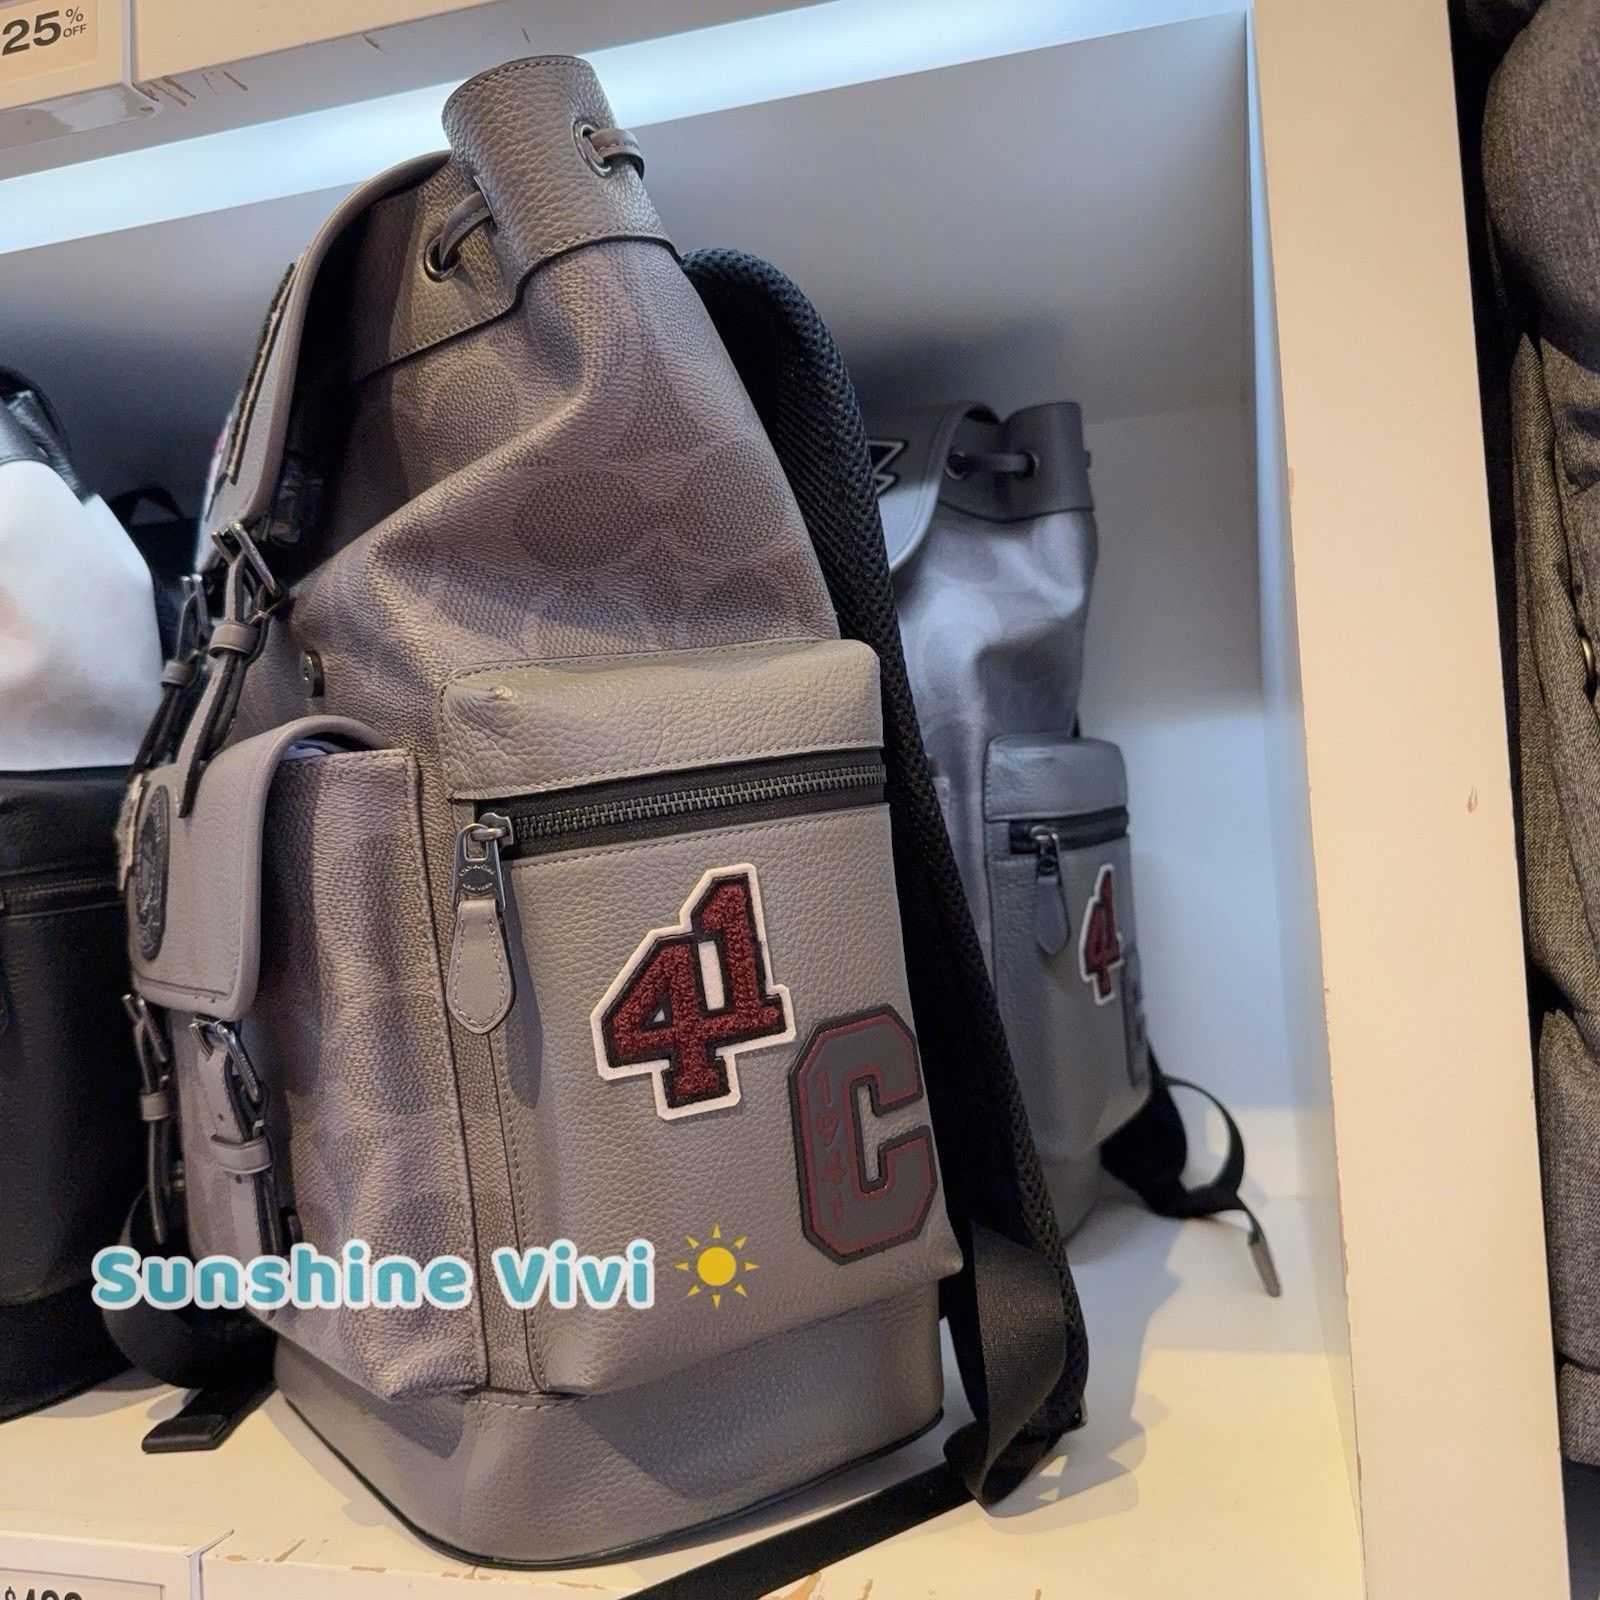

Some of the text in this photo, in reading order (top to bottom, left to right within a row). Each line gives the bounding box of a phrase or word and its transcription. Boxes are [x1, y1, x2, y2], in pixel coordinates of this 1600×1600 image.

[63, 23, 87, 38] OFF
[590, 863, 797, 1121] 41
[788, 1003, 939, 1266] C
